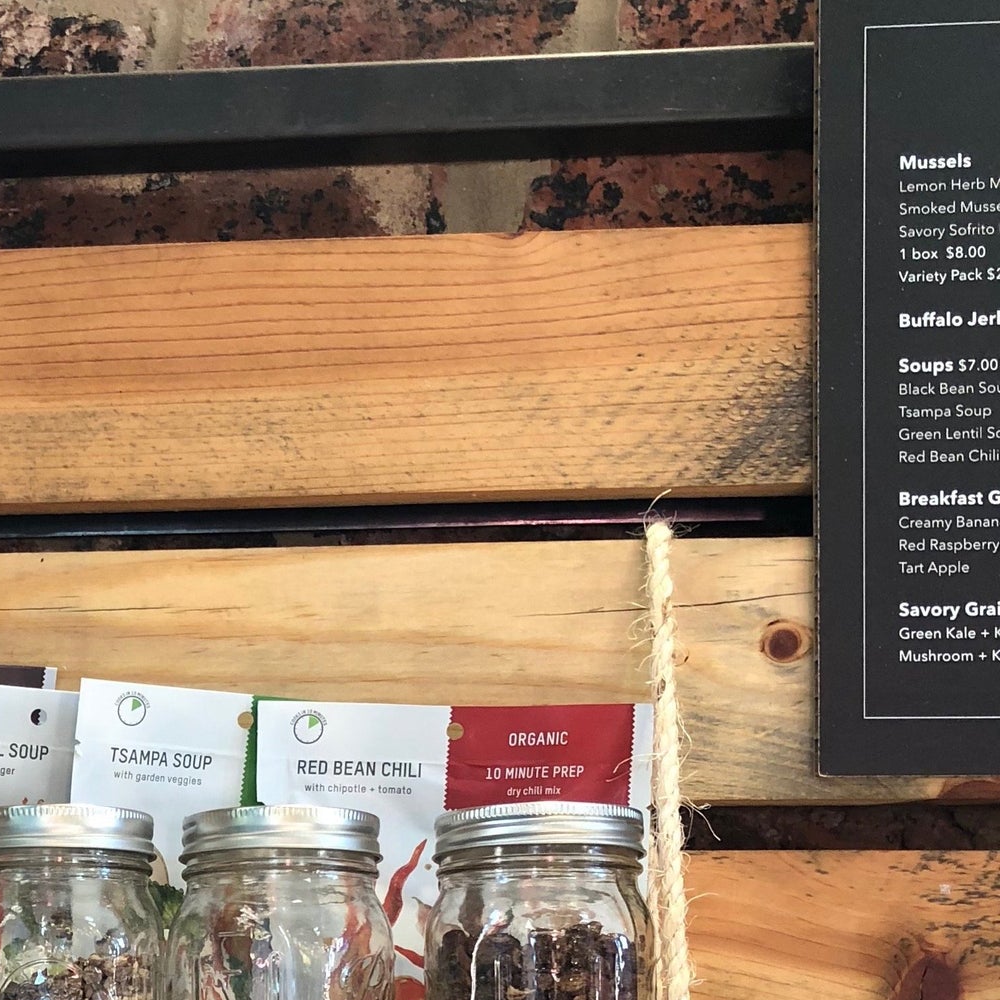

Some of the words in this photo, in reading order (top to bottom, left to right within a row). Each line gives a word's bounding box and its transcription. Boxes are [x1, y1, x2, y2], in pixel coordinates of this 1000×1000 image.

[900, 153, 972, 170] Mussels
[900, 180, 947, 193] Lemon
[951, 177, 986, 191] Herb
[899, 200, 956, 216] Smoked
[899, 225, 946, 240] Savory
[949, 222, 995, 237] Sofrito
[900, 248, 906, 260] 1
[912, 247, 938, 260] box
[946, 245, 986, 259] $8.00
[899, 270, 947, 285] Variety
[951, 268, 982, 281] Pack
[899, 311, 963, 328] Buffalo
[898, 358, 954, 376] Soups
[958, 358, 998, 372] $7.00
[899, 382, 935, 395] Black
[940, 382, 974, 395] Bean
[898, 405, 951, 420] Tsampa
[956, 404, 992, 419] Soup
[898, 428, 941, 441] Green
[946, 427, 983, 440] Lentil
[899, 450, 926, 463] Red
[930, 450, 965, 463] Bean
[968, 449, 1000, 462] Chili
[899, 489, 983, 506] Breakfast
[898, 516, 952, 531] Creamy
[899, 538, 926, 551] Red
[930, 538, 1000, 553] Raspberry
[899, 561, 924, 574] Tart
[927, 561, 970, 576] Apple
[899, 602, 961, 621] Savory
[898, 627, 942, 640] Green
[946, 626, 976, 639] Kale
[899, 649, 974, 662] Mushroom
[508, 731, 568, 747] ORGANIC
[8, 742, 50, 761] SOUP
[110, 747, 169, 768] TSAMPA
[172, 753, 213, 771] SOUP
[297, 759, 329, 775] RED
[333, 760, 376, 777] BEAN
[381, 761, 423, 779] CHILI
[485, 767, 501, 780] 10
[505, 766, 549, 780] MINUTE
[552, 765, 585, 778] PREP
[113, 770, 134, 781] with
[135, 773, 165, 784] garden
[167, 774, 203, 786] veggies
[304, 783, 326, 793] with
[327, 784, 367, 795] chipotle
[377, 785, 413, 795] tomato
[506, 786, 521, 797] dry
[522, 786, 543, 796] chili
[544, 786, 561, 795] mix
